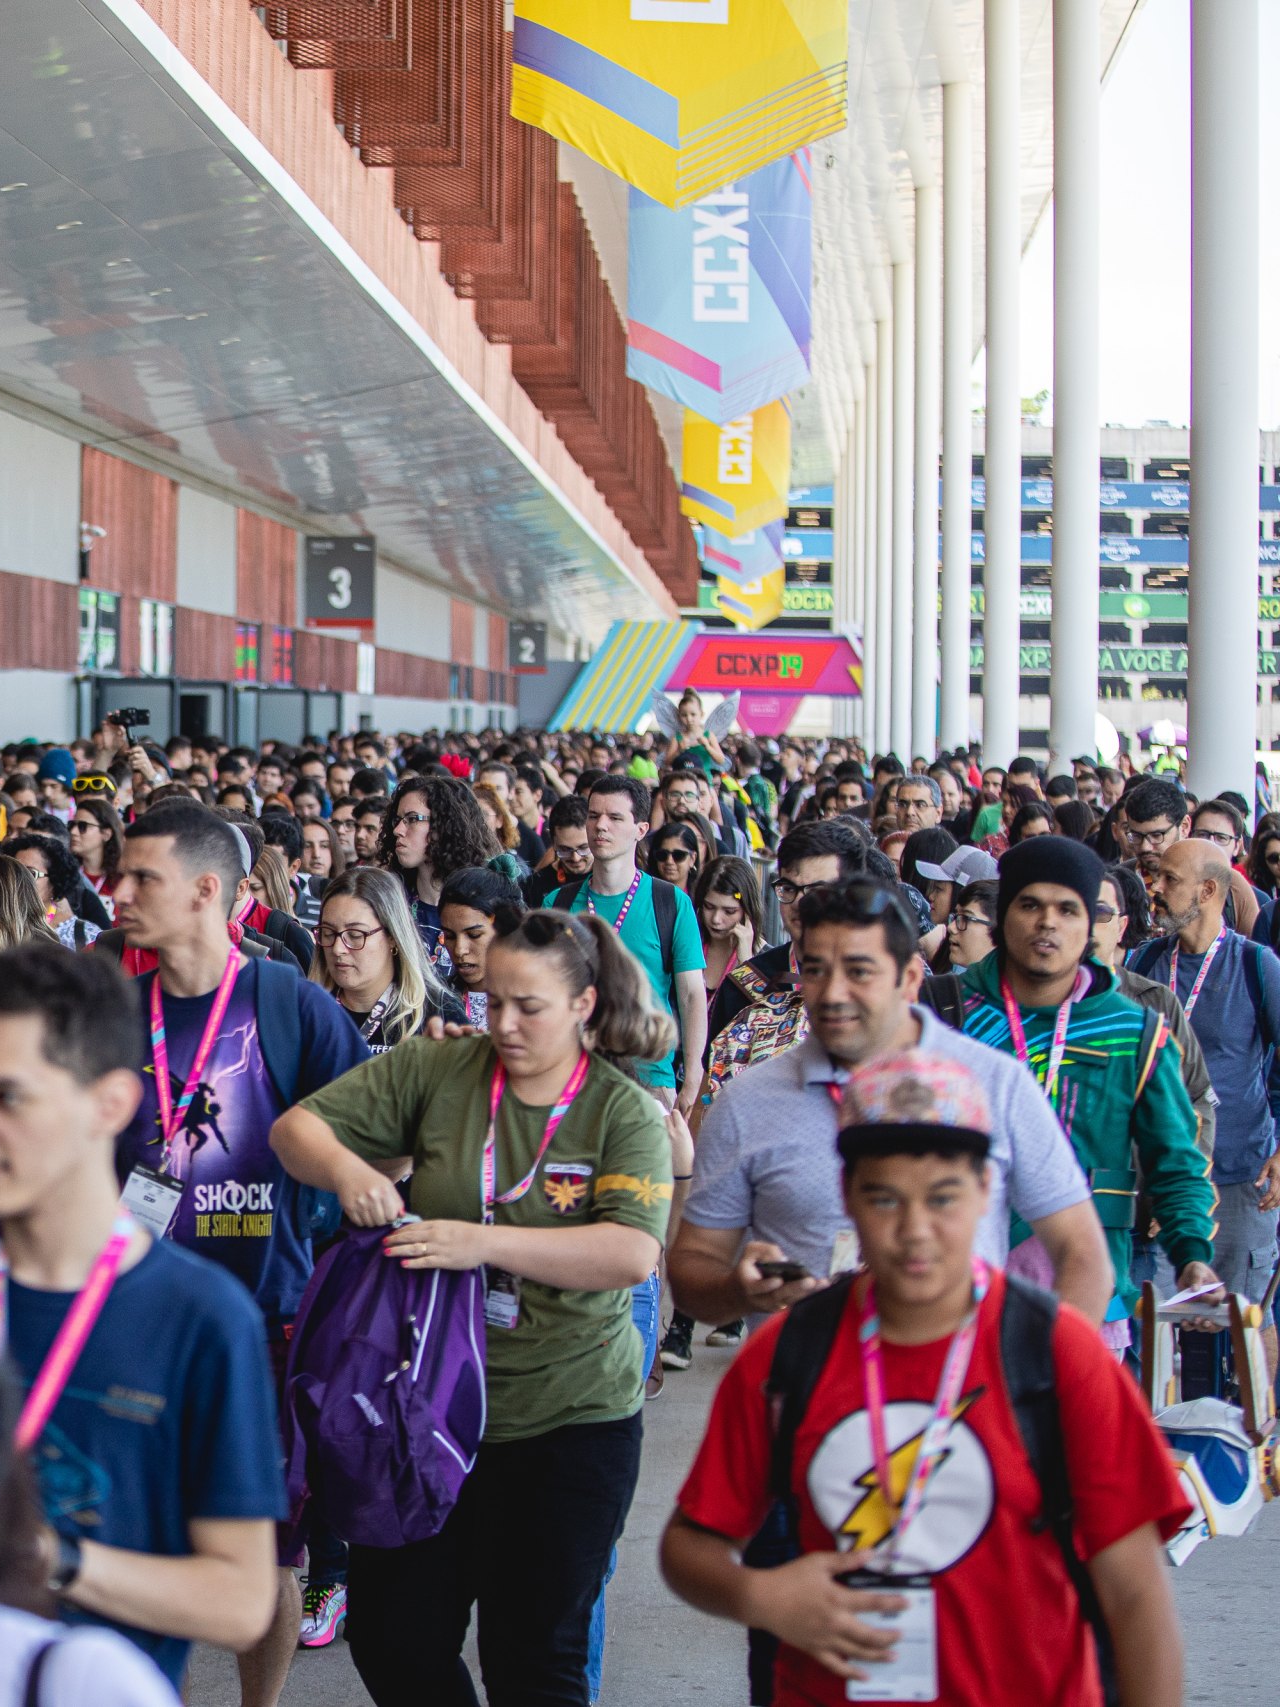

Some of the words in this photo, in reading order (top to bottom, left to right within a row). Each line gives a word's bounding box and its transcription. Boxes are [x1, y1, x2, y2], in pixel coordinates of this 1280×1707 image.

[328, 566, 352, 609] 3
[519, 640, 536, 664] 2
[194, 1181, 274, 1215] SHOCK
[195, 1214, 211, 1237] THE
